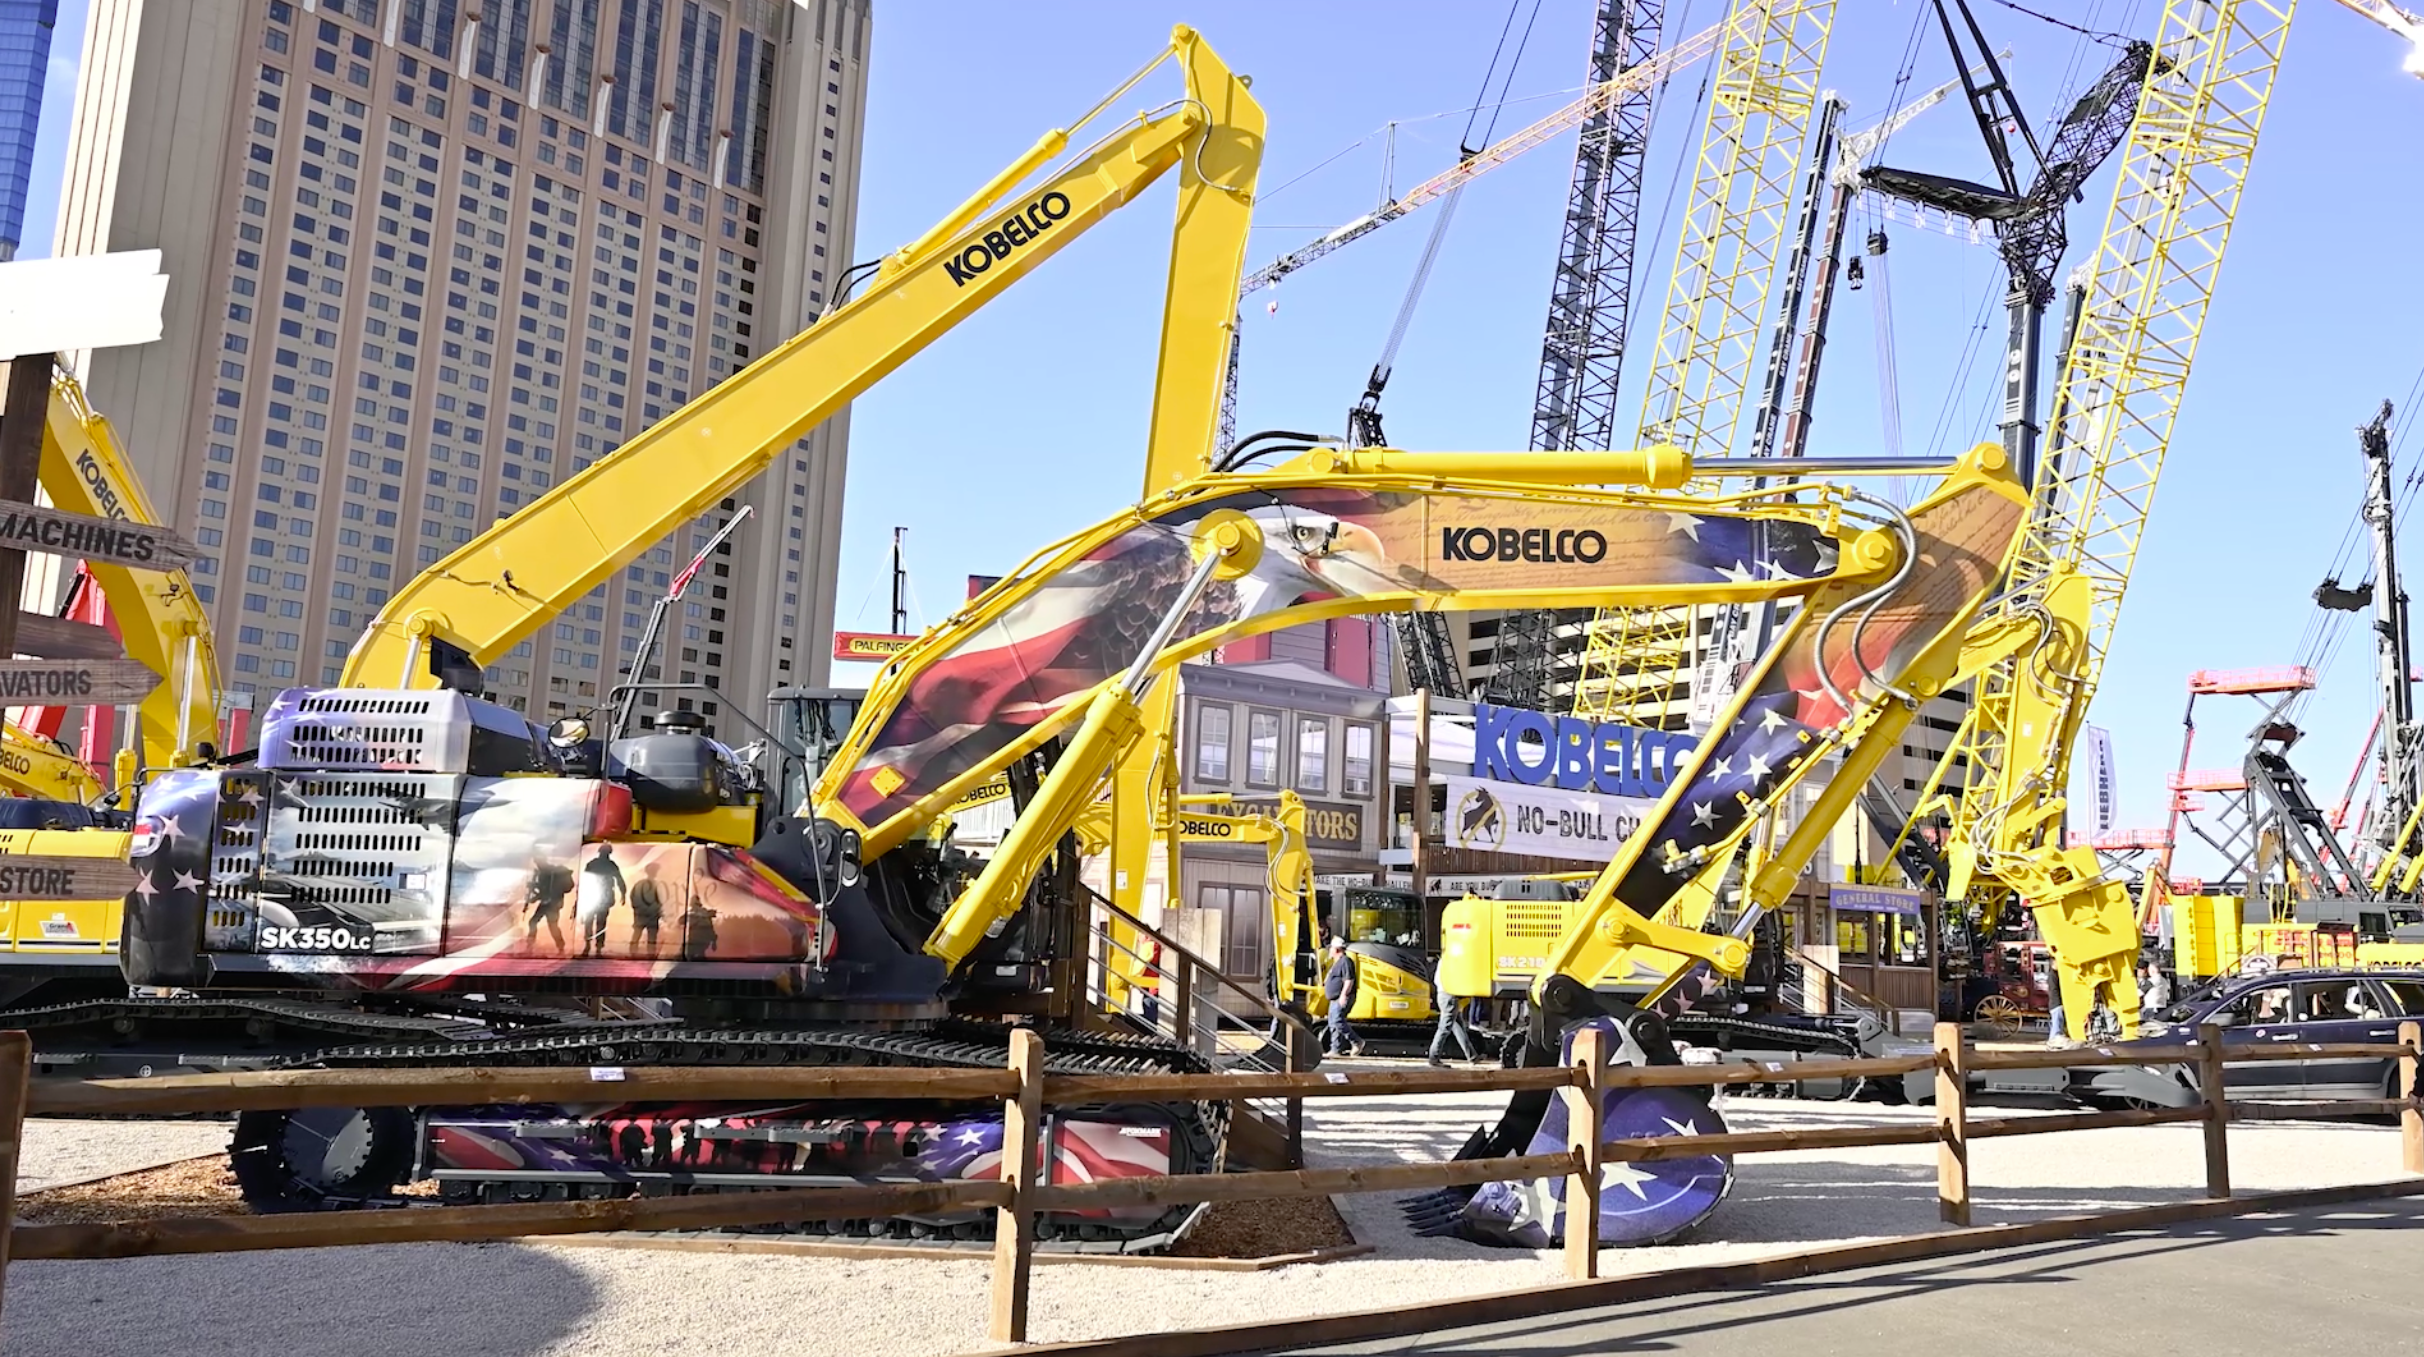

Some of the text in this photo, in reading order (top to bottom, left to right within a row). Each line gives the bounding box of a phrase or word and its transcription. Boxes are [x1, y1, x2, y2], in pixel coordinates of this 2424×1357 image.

[943, 191, 1071, 288] KOBELCO
[1443, 526, 1607, 564] KOBELCO
[0, 669, 92, 698] VATORS
[0, 748, 30, 775] BELCO
[1474, 703, 1700, 799] KOBELCO
[1179, 821, 1231, 836] OBELCO
[1517, 804, 1608, 841] NO-BULL
[0, 866, 76, 895] STORE
[1835, 893, 1882, 907] GENERAL
[1884, 894, 1916, 912] STORE
